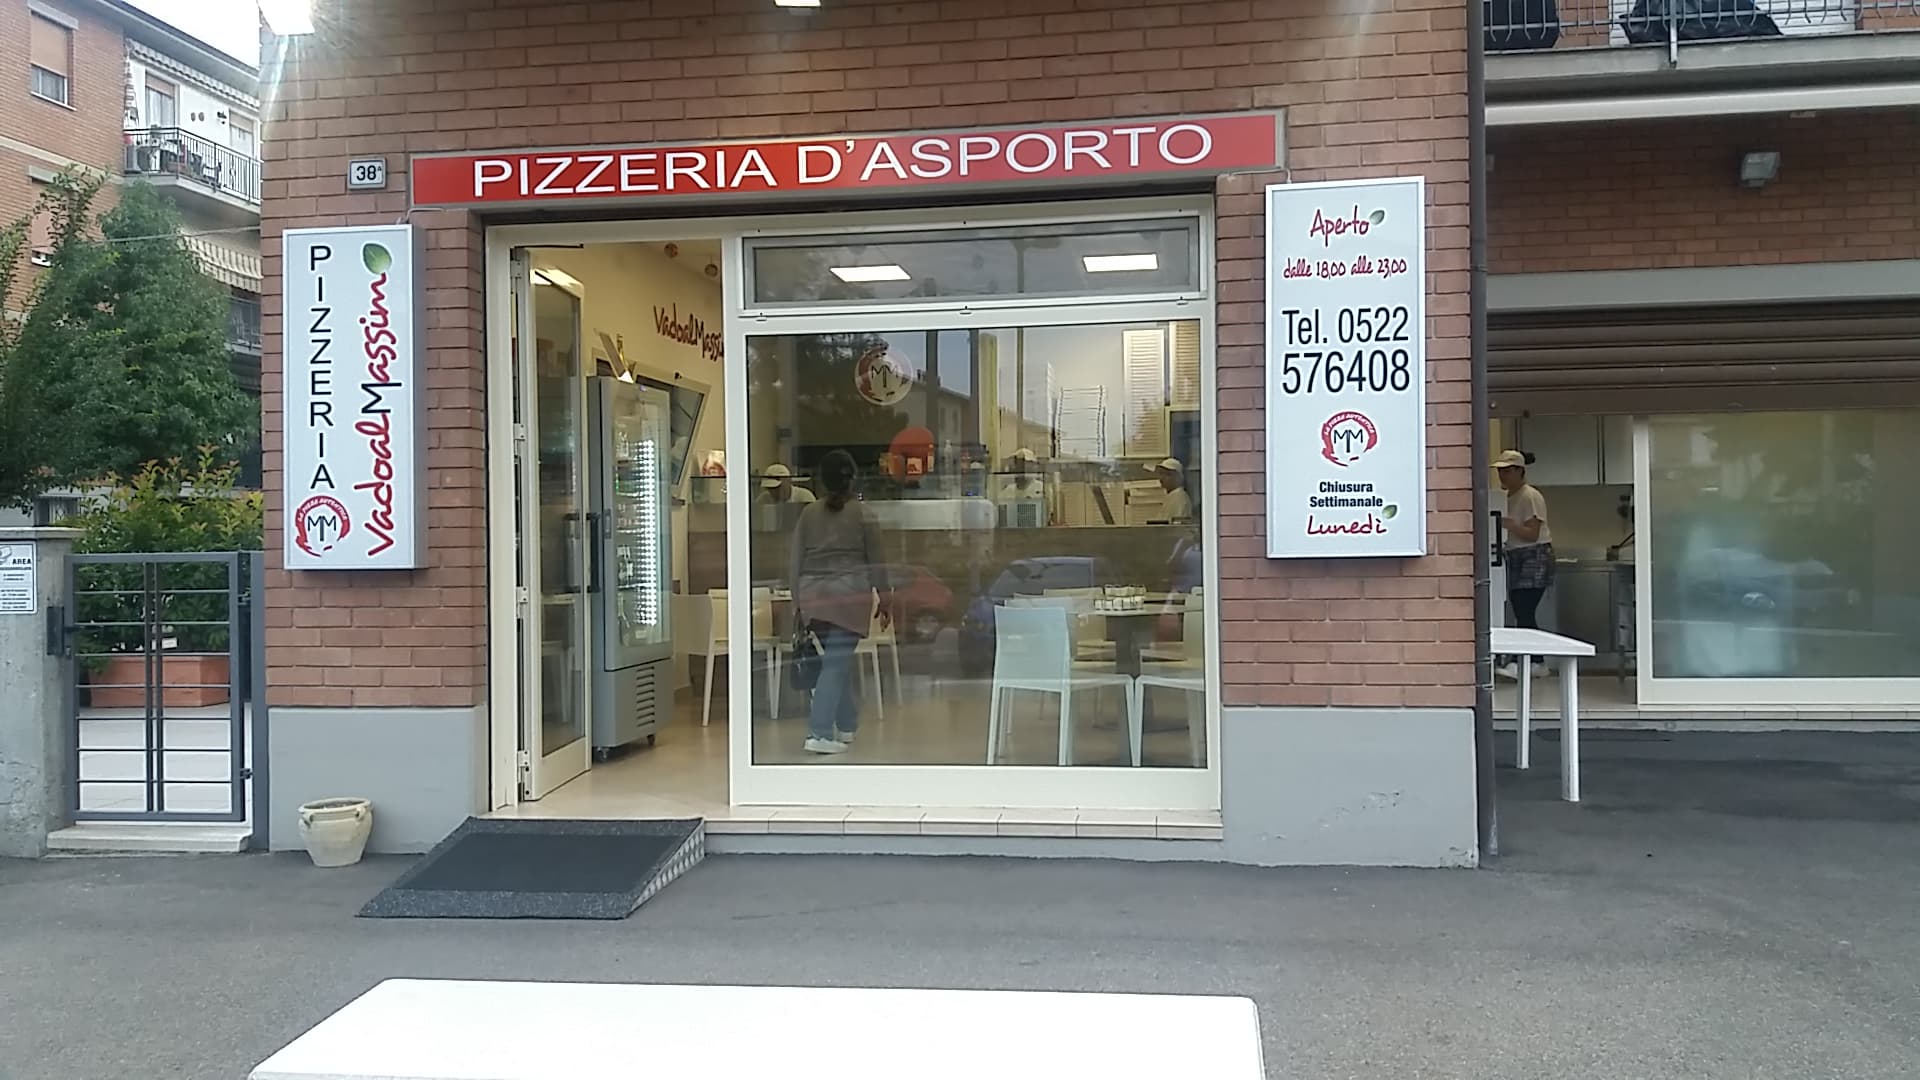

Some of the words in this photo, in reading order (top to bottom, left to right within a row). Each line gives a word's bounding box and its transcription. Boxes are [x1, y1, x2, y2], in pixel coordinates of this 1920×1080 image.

[474, 149, 778, 198] PIZZERIA
[797, 124, 1213, 185] D'ASPORTO
[1310, 204, 1370, 248] Aperto
[1283, 257, 1313, 279] dalle
[1351, 255, 1374, 276] alle
[1282, 308, 1328, 345] Tel.
[1338, 306, 1409, 343] 0522
[310, 245, 335, 489] PIZZERIA
[1282, 348, 1410, 394] 576408
[1309, 495, 1383, 507] Settimanale
[1319, 481, 1373, 493] Chiusura
[1307, 512, 1387, 535] Lunedì
